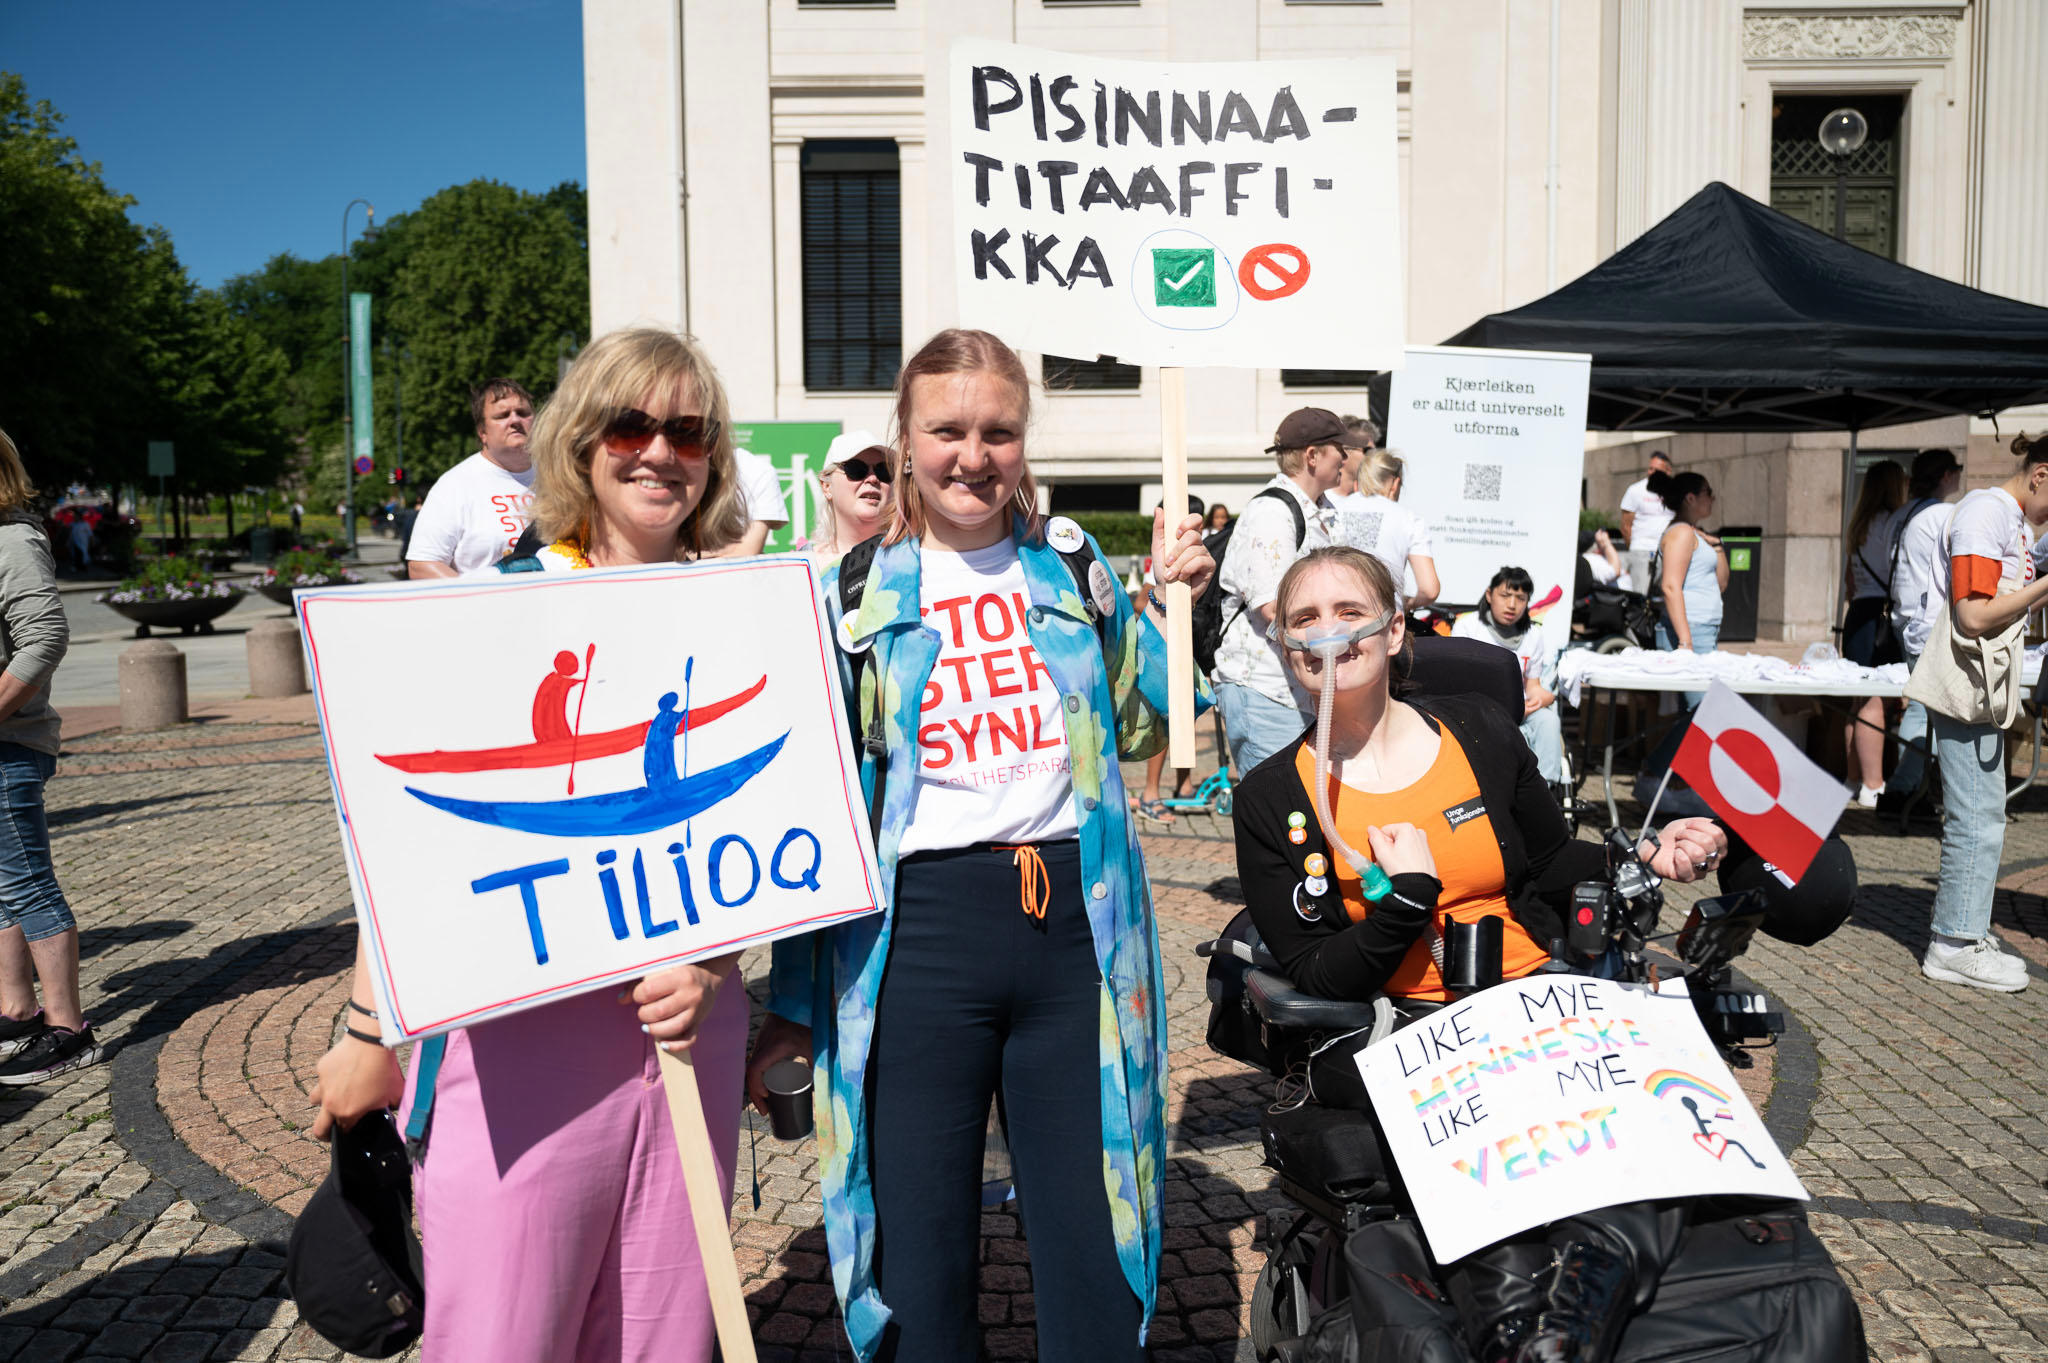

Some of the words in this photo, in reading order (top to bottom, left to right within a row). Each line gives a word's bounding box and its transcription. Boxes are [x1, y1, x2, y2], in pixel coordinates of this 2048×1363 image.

[971, 227, 1114, 291] KKA
[1412, 400, 1430, 411] er
[1434, 398, 1476, 413] alltid
[1481, 401, 1566, 418] universelt
[1445, 377, 1536, 394] Kjærleiken
[1453, 421, 1520, 437] utforma
[1445, 807, 1464, 818] Unge
[1395, 1006, 1475, 1078] LIKE
[1519, 983, 1604, 1022] MYE
[1408, 1016, 1650, 1118] MENNESKE
[1422, 1094, 1489, 1147] LIKE
[1557, 1053, 1636, 1096] MYE
[1452, 1105, 1618, 1187] VERDT
